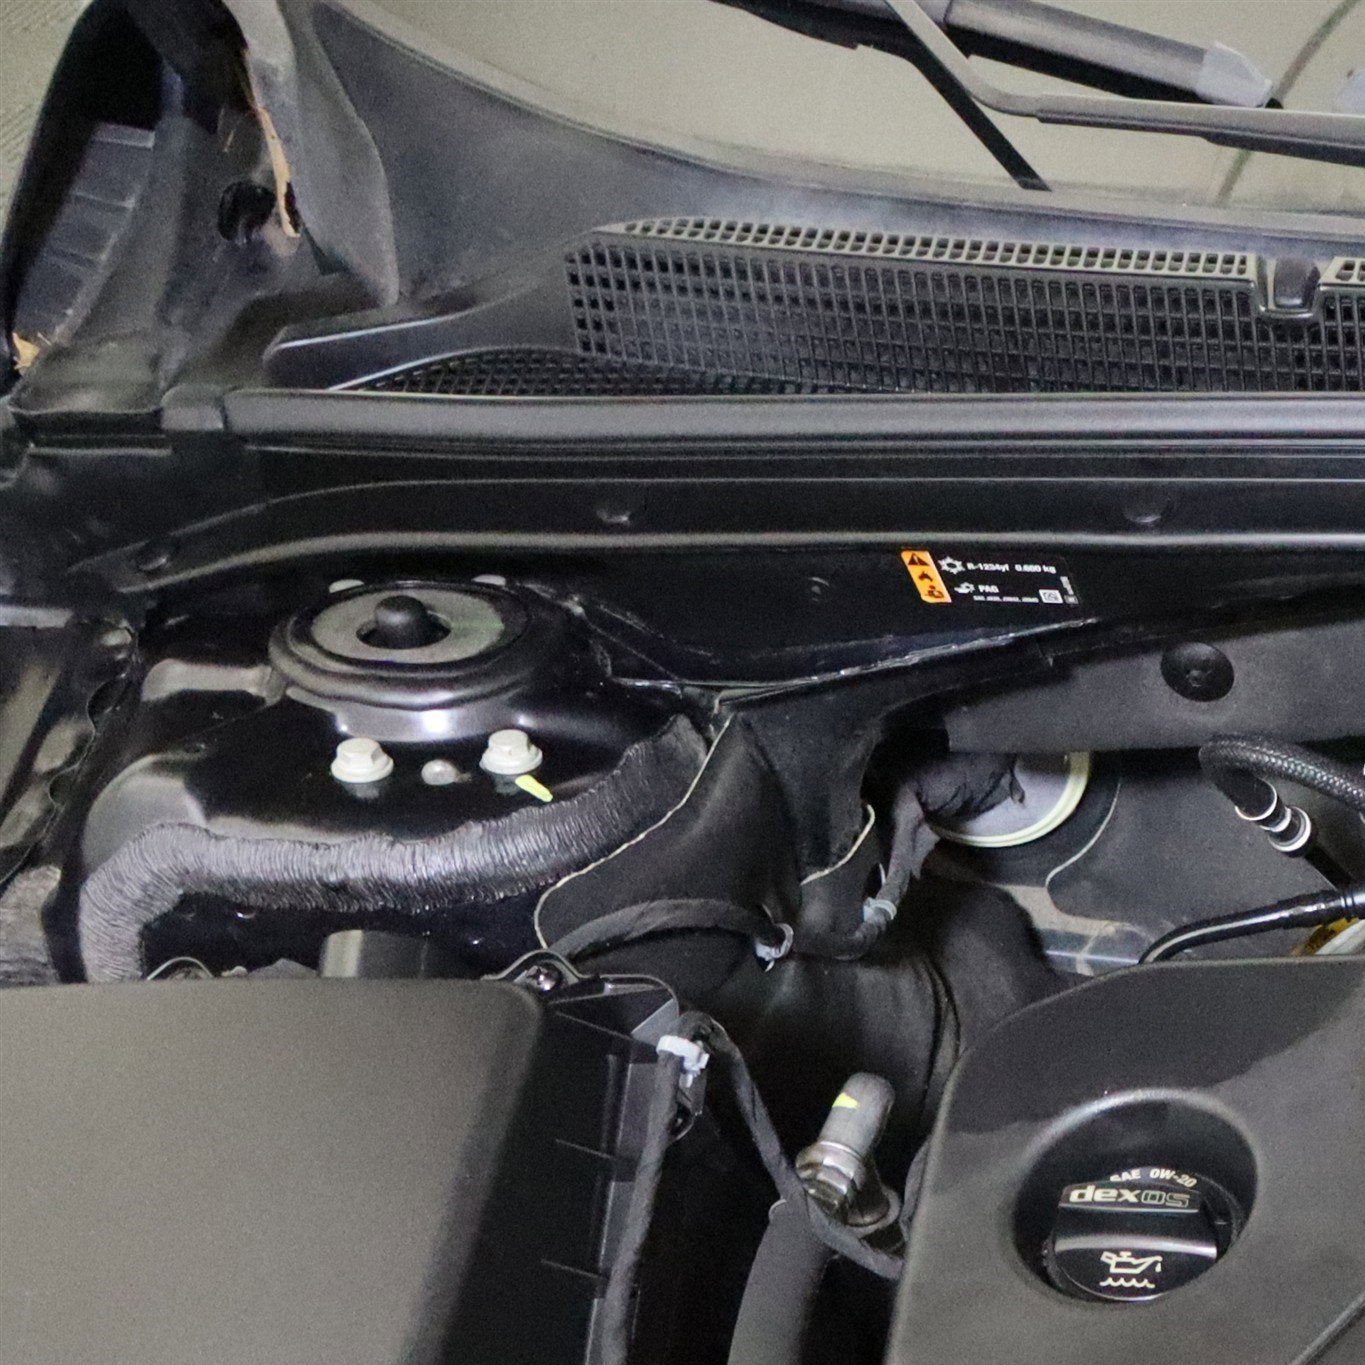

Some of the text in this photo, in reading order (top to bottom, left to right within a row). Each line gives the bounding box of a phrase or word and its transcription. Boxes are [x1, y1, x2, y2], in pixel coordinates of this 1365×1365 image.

[1110, 1168, 1197, 1188] SAE 0W-20
[1069, 1185, 1190, 1208] dexos
